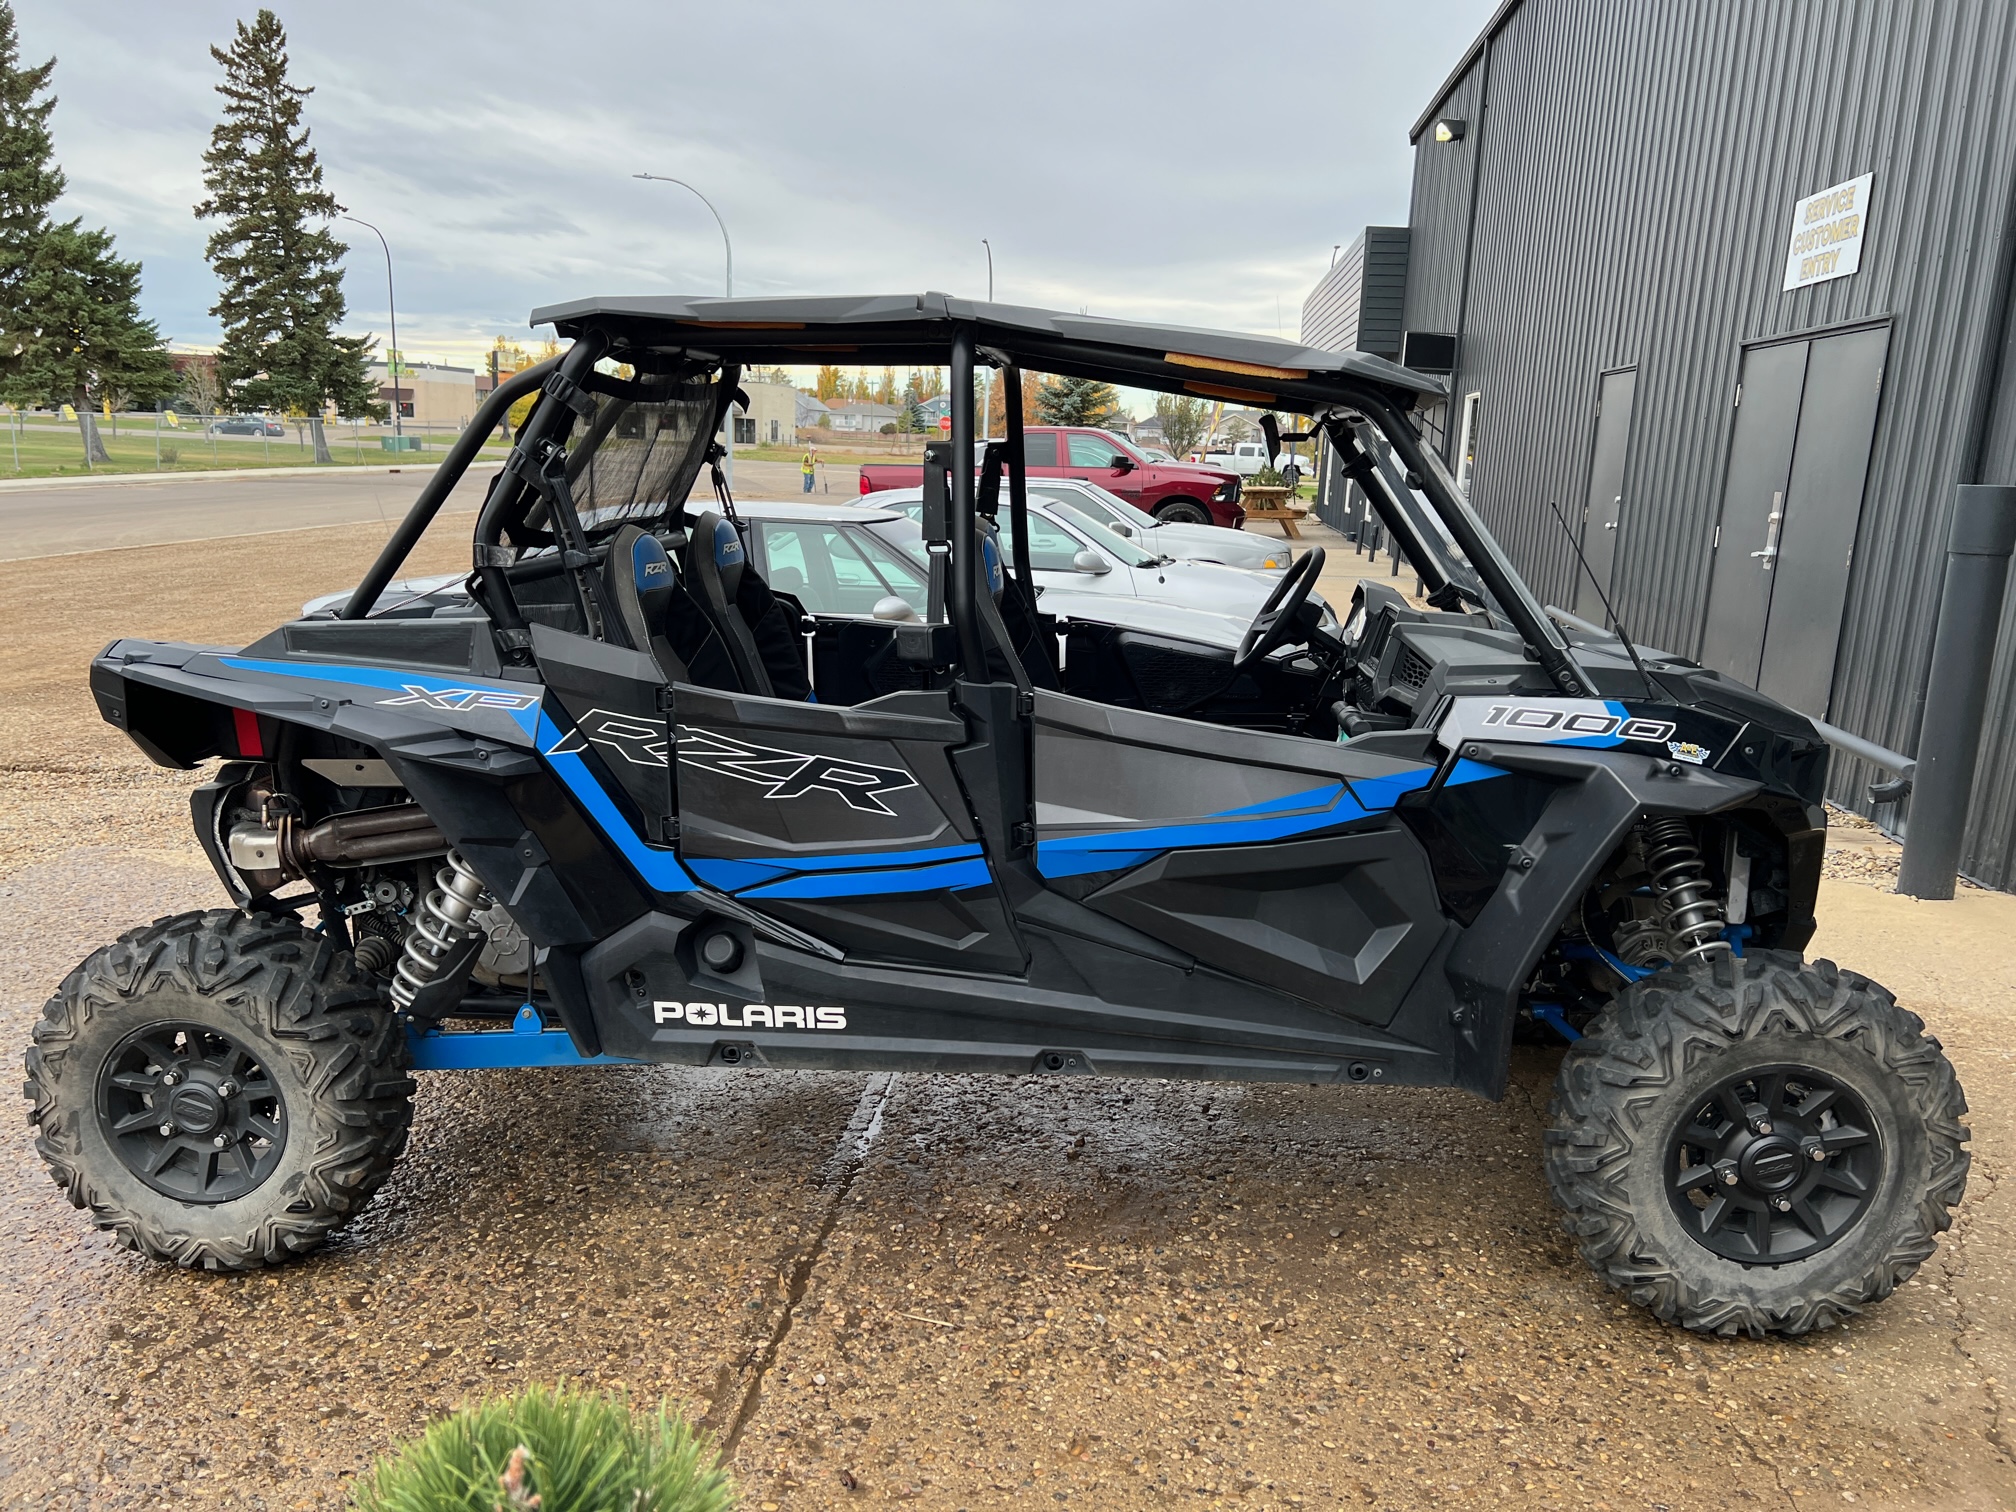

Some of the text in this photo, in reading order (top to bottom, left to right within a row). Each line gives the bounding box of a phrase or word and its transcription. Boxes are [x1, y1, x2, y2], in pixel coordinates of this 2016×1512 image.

[1804, 185, 1856, 226] SERVICE
[1793, 214, 1860, 256] CUSTOMER
[1800, 247, 1842, 281] ENTRY
[722, 541, 740, 555] RZR
[645, 562, 667, 578] RZR
[374, 684, 540, 711] XP
[1482, 704, 1677, 743] 1000
[545, 708, 919, 816] RZR
[653, 1001, 847, 1030] POLARIS
